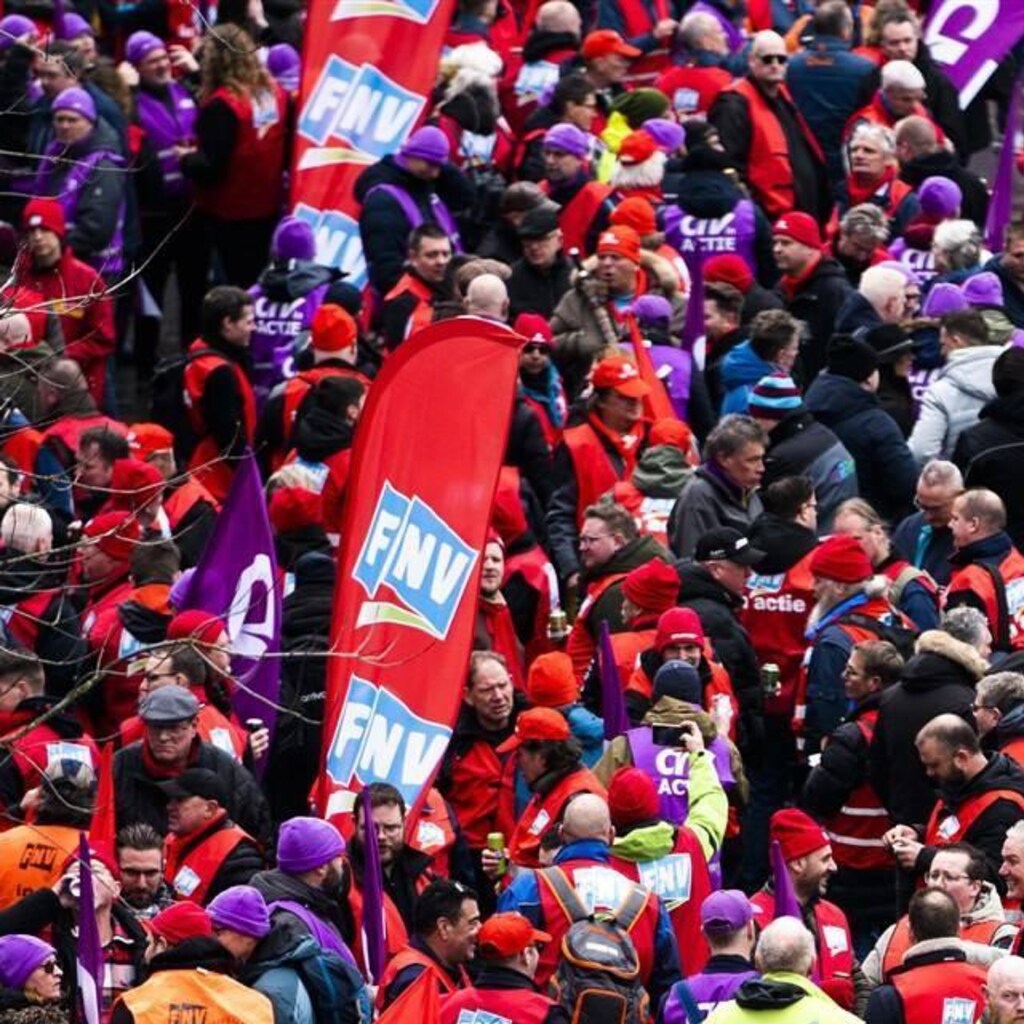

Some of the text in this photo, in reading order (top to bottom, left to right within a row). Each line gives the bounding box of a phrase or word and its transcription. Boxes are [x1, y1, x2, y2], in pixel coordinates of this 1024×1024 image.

[306, 76, 417, 144] FNV
[680, 238, 737, 251] ATIE
[364, 510, 470, 606] FNV
[753, 595, 807, 613] actie
[333, 701, 450, 787] FNV
